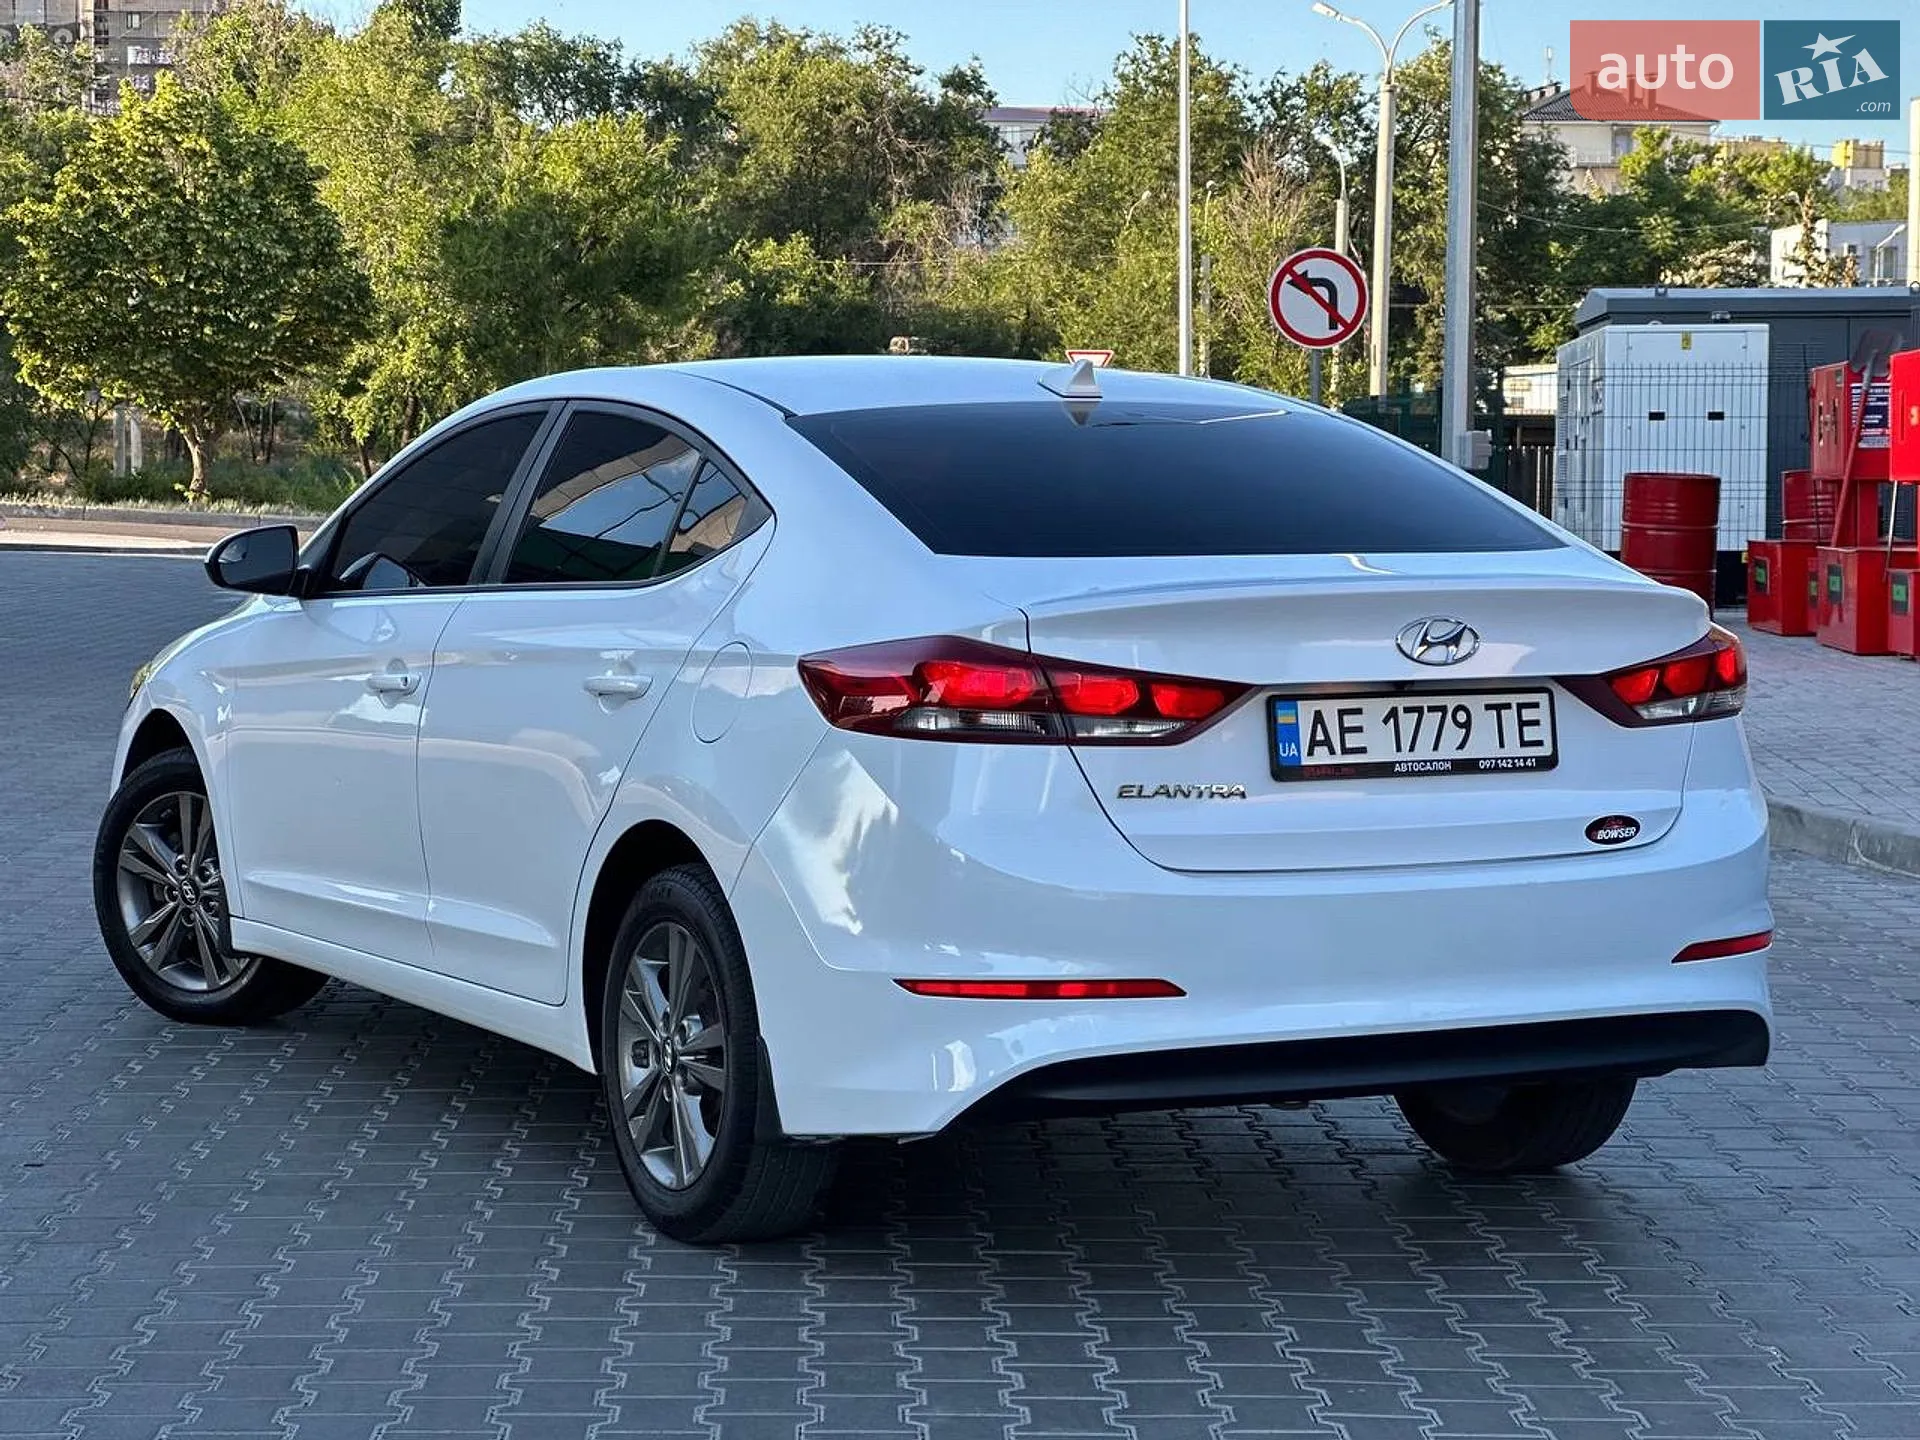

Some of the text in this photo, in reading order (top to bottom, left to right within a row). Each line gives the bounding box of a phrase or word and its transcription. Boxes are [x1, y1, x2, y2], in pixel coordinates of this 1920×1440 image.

[1306, 702, 1544, 757] AE 1779 TE
[1279, 742, 1298, 757] UA
[1394, 761, 1452, 772] АВТОСАЛОН
[1117, 784, 1247, 800] ELANTRA
[1597, 826, 1636, 840] BOWSER
